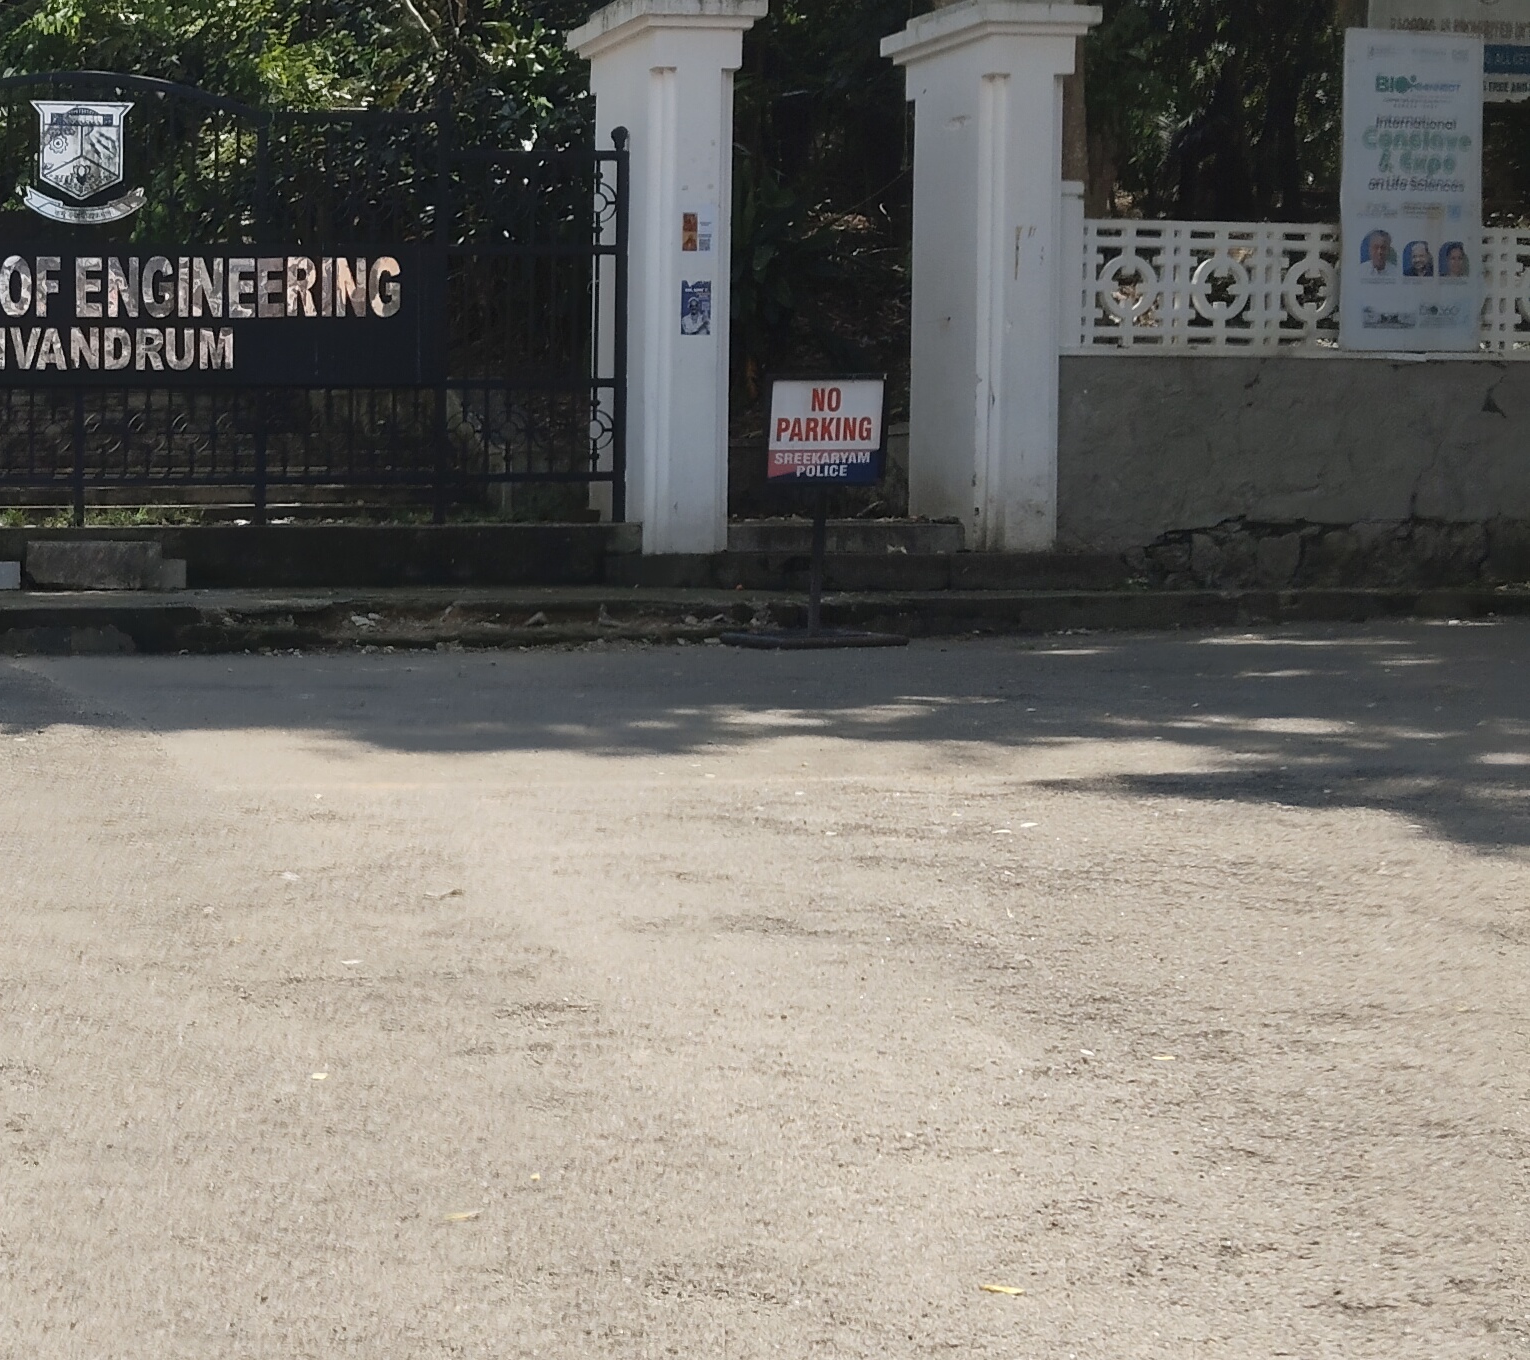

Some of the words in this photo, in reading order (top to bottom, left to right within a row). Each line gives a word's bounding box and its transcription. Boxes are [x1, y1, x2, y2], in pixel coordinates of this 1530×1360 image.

[74, 255, 402, 318] ENGINEERING
[811, 387, 842, 412] NO
[776, 416, 872, 442] PARKING
[774, 451, 870, 465] SREEKARYAM
[796, 464, 848, 478] POLICE
